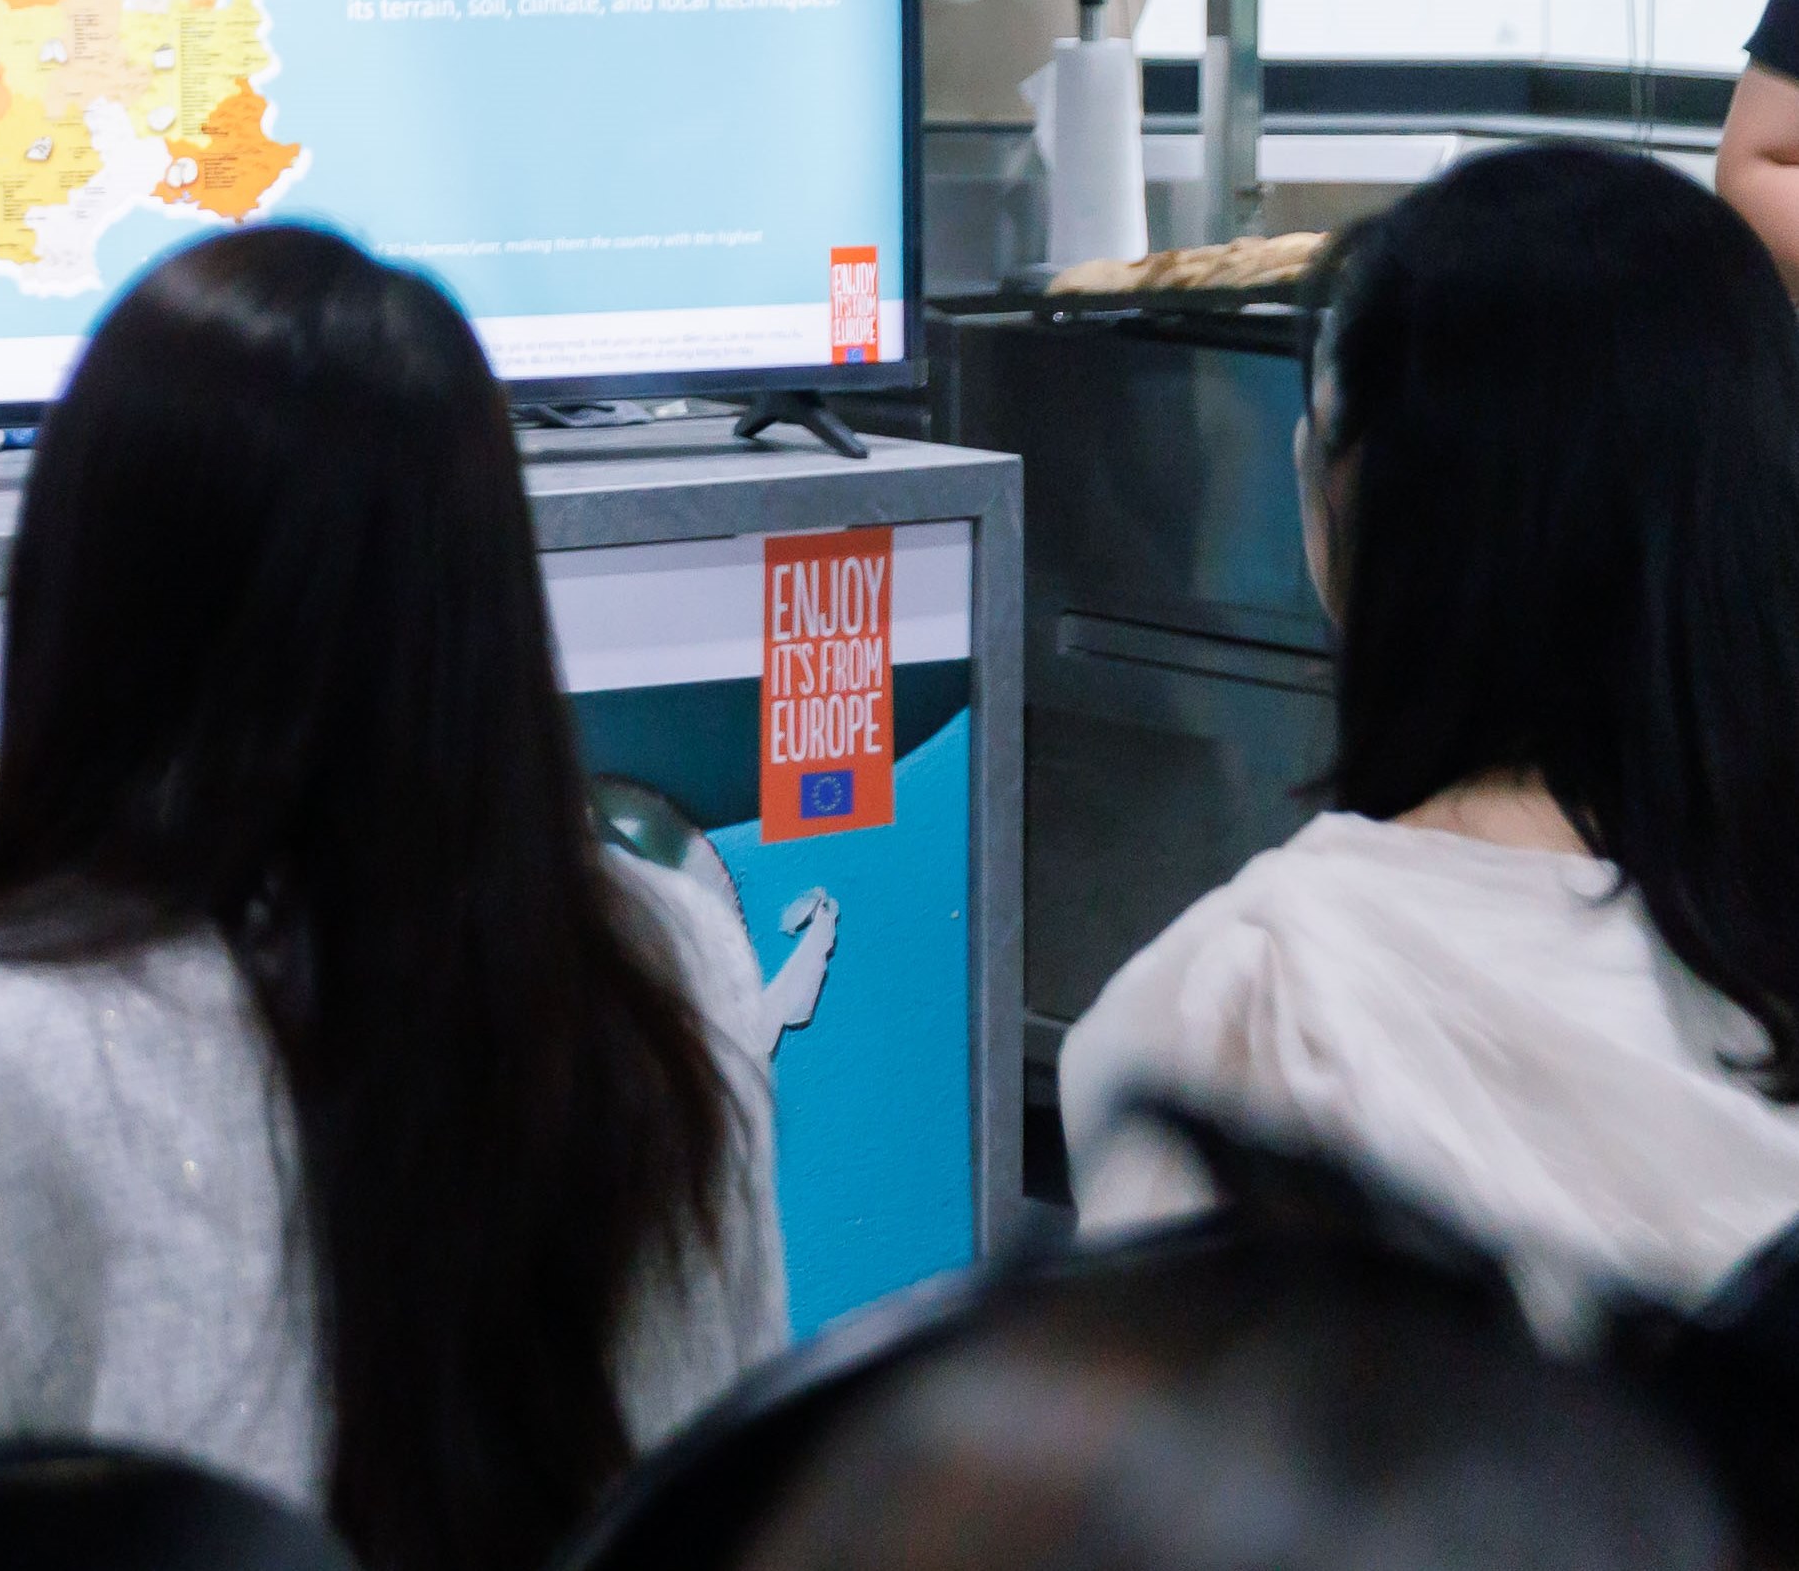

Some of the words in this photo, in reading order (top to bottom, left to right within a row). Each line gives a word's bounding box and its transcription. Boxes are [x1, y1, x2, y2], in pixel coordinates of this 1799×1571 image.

[833, 262, 877, 294] ENJOY
[771, 556, 885, 641] ENJOY
[770, 642, 815, 698] IT'S
[819, 636, 883, 693] FROM
[770, 691, 883, 765] EUROPE
